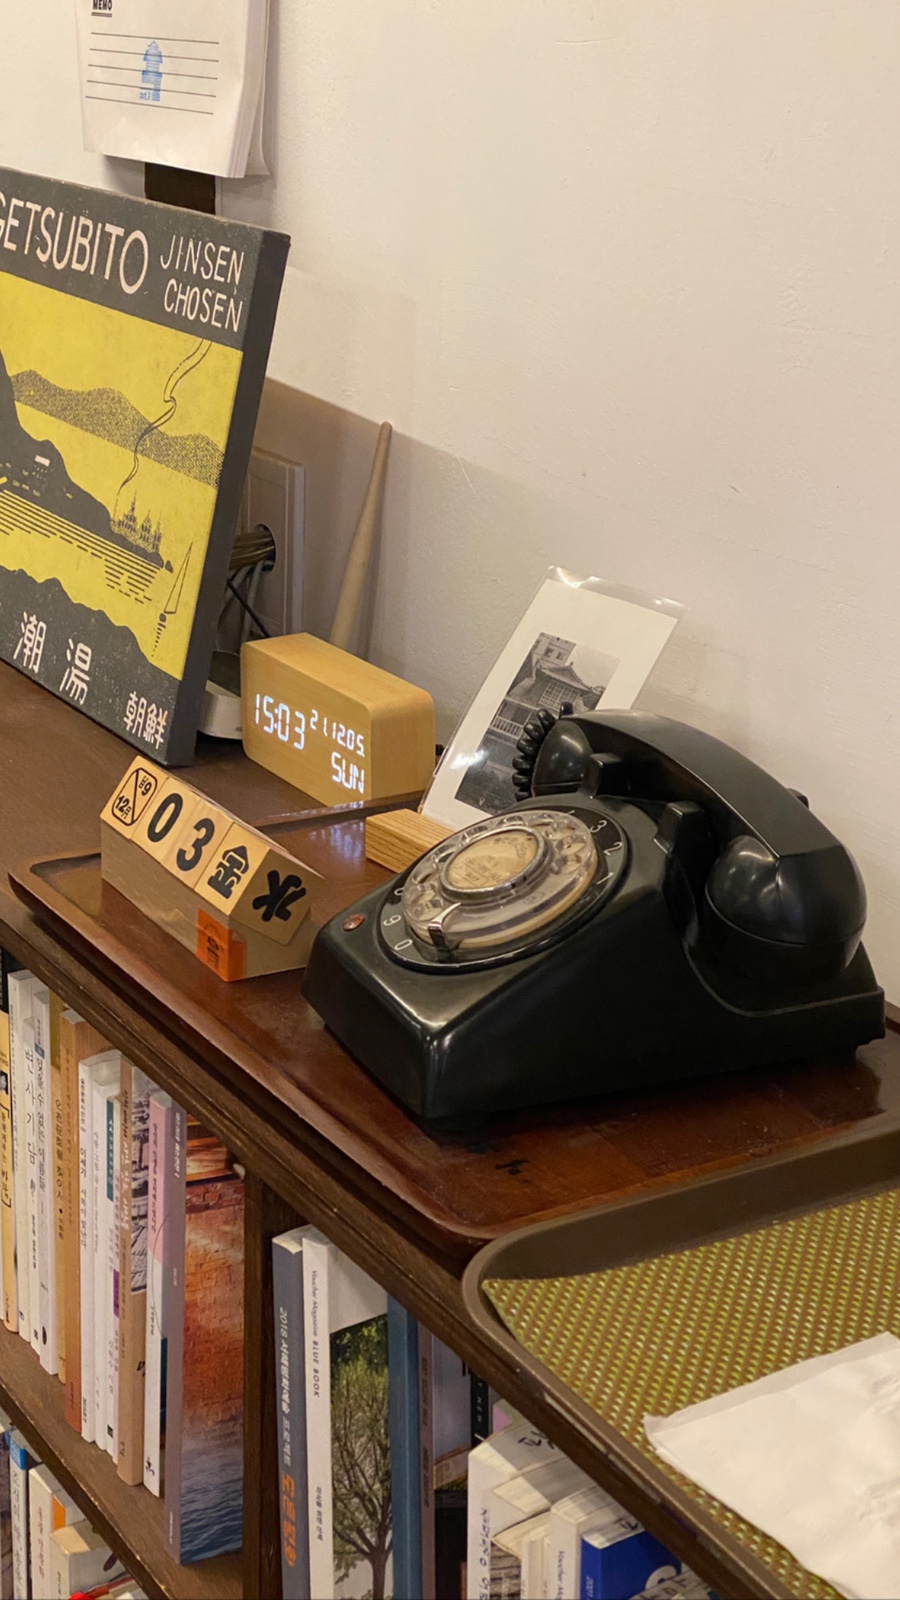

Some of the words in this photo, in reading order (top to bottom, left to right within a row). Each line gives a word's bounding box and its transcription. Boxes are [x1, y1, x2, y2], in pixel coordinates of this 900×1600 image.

[92, 0, 113, 11] MEMO
[160, 235, 244, 286] JINSEN
[164, 279, 243, 333] CHOSEN
[123, 691, 169, 750] 朝鮮
[331, 751, 364, 794] SUN
[279, 1307, 288, 1339] 2018
